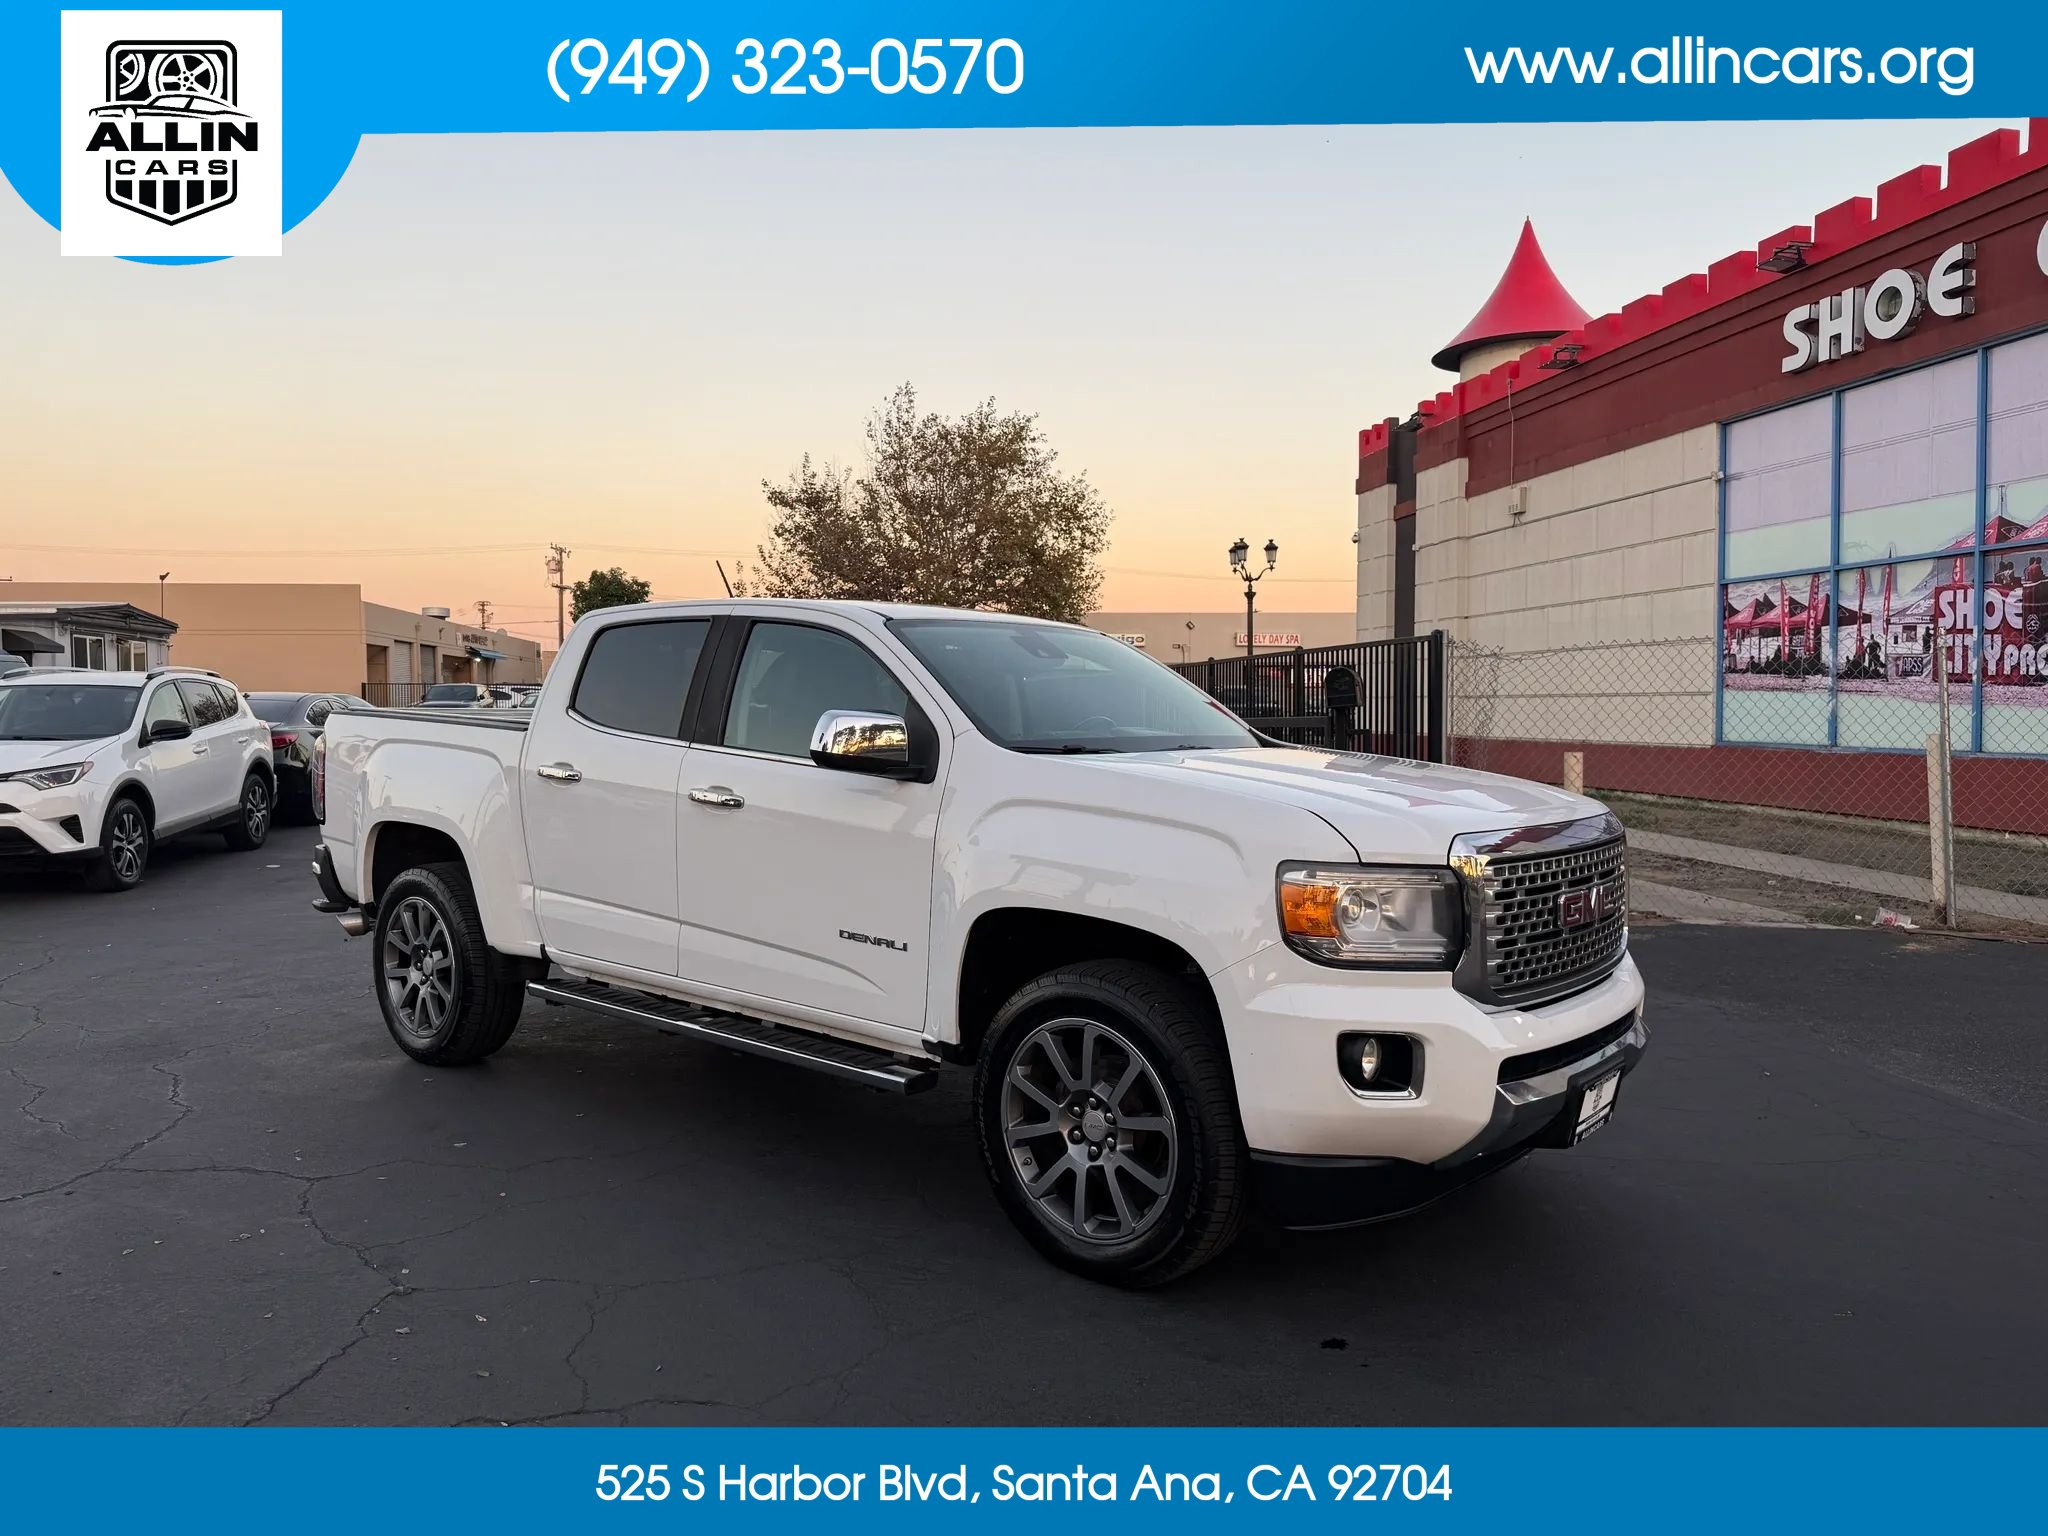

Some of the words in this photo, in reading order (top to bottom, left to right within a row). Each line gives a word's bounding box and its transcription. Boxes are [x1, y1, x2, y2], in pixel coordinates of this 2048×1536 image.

[1781, 240, 1977, 374] SHOE
[1937, 587, 2023, 631] SHOE
[1238, 634, 1267, 645] LOELY
[1269, 634, 1284, 645] DAY
[1285, 634, 1300, 645] SPA
[1558, 881, 1618, 929] GMC
[839, 928, 908, 952] DENALI
